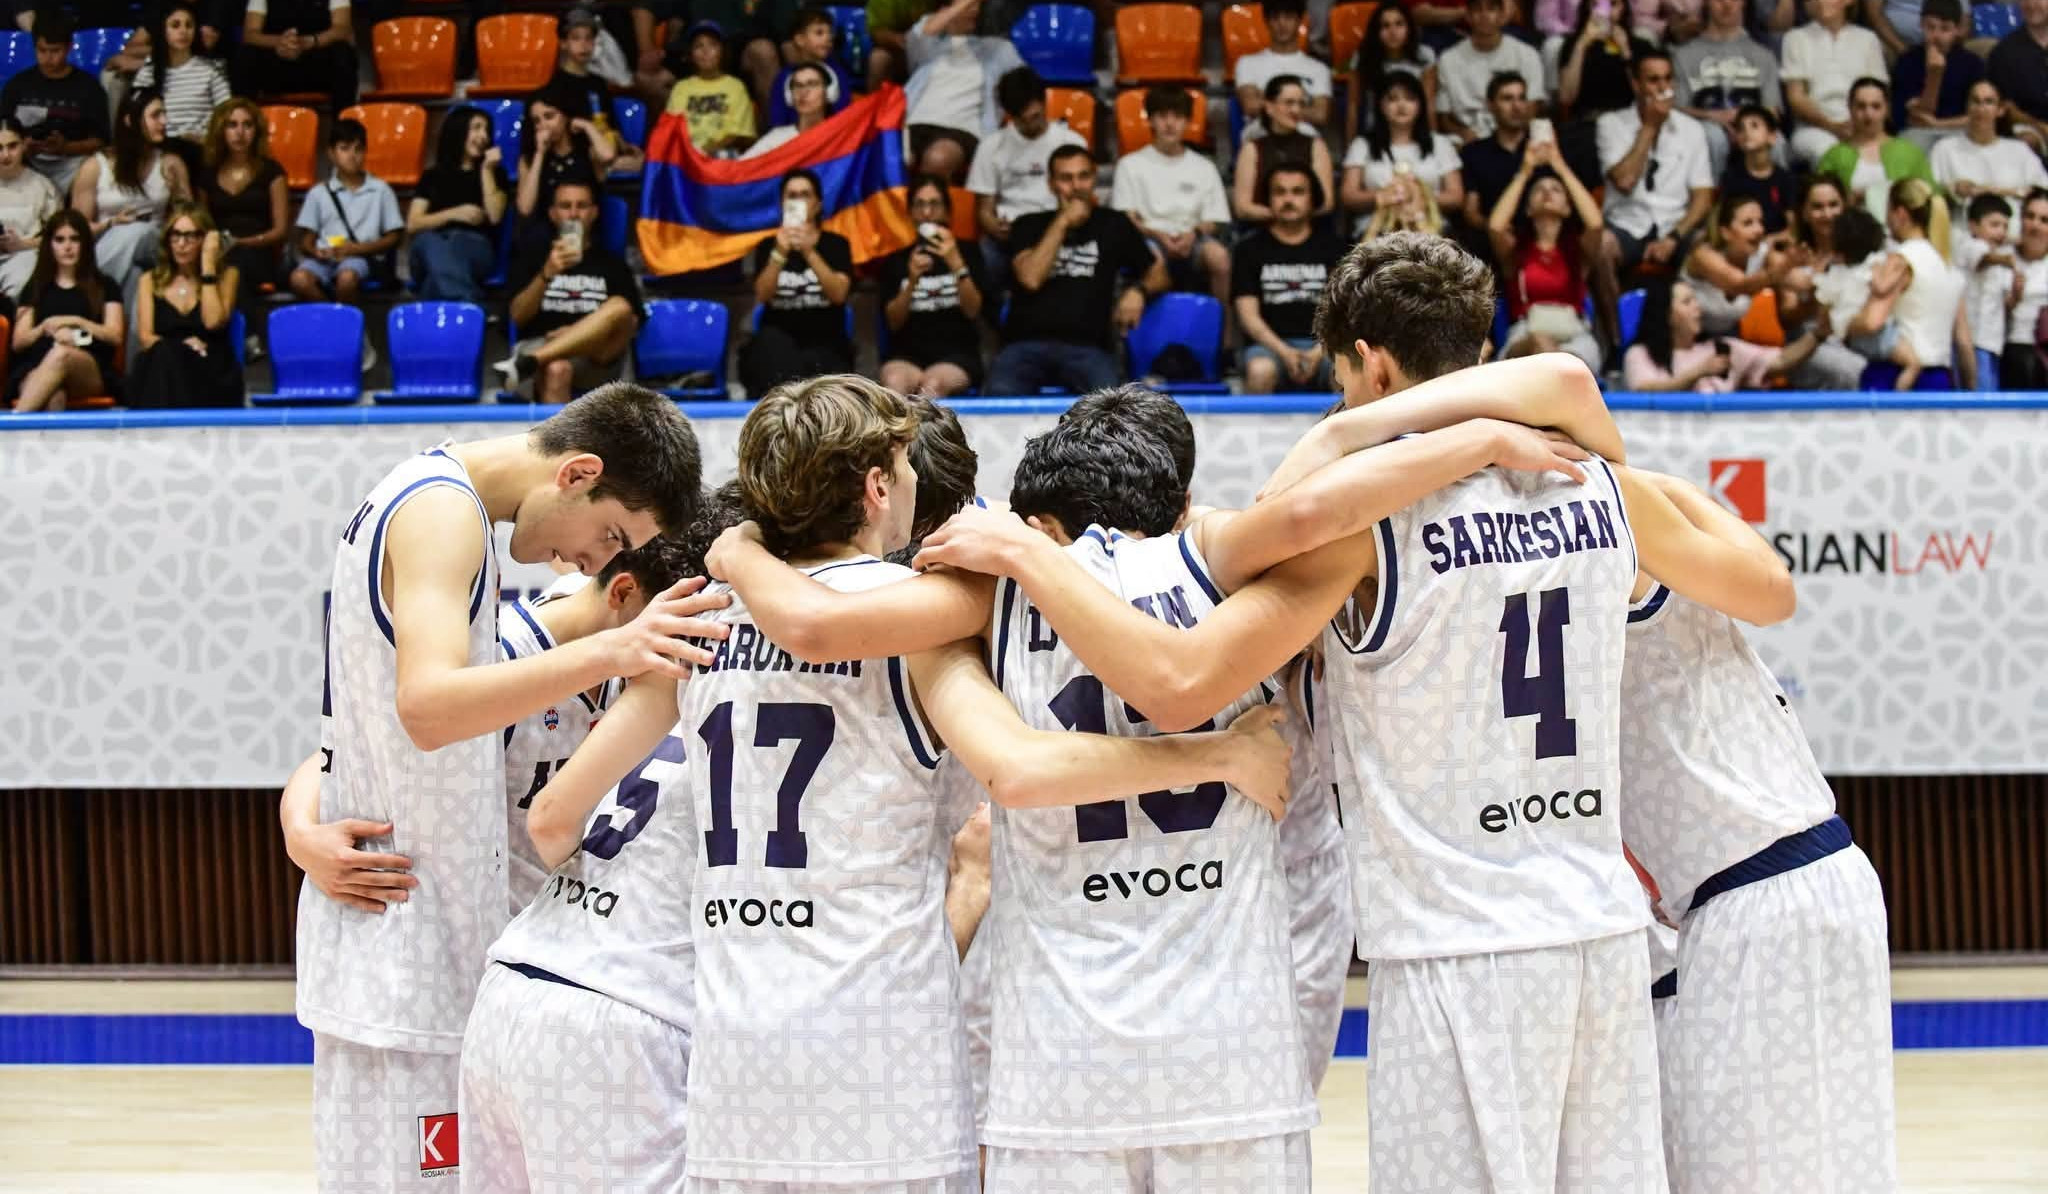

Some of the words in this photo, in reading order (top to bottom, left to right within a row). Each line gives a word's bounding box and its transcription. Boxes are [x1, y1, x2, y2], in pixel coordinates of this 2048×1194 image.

[1422, 500, 1618, 575] SARKESIAN
[1499, 586, 1577, 760] 4
[698, 701, 836, 868] 17
[1479, 789, 1602, 833] evoca
[1083, 860, 1223, 903] evoca
[704, 898, 814, 928] evoca
